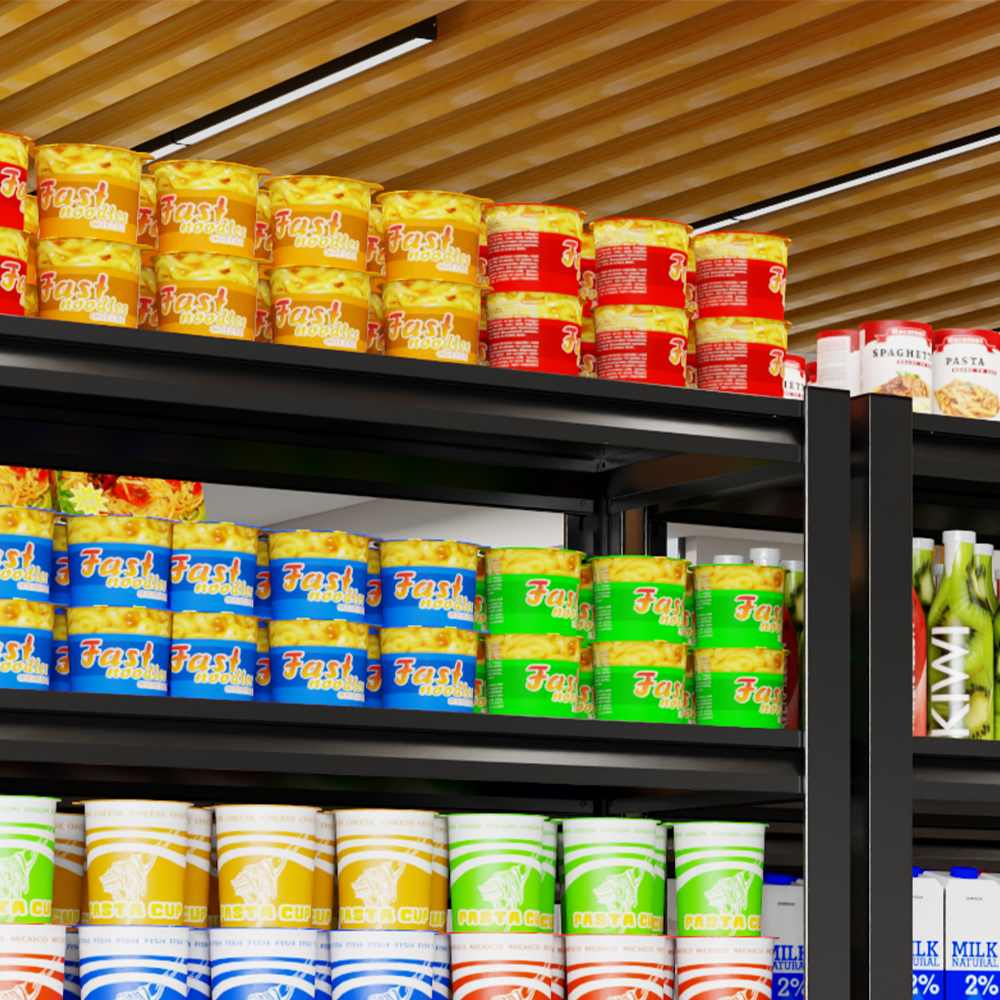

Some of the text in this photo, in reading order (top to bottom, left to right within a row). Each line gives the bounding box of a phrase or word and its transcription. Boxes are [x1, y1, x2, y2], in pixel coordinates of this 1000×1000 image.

[40, 179, 109, 210] Fast
[59, 204, 128, 222] noodles
[161, 194, 227, 225] Fast
[180, 218, 247, 237] noodles
[275, 209, 342, 239] Fast
[295, 233, 359, 253] noodles
[388, 224, 454, 253] Fast
[408, 247, 471, 266] noodles
[40, 271, 109, 302] Fast
[59, 296, 128, 314] noodles
[161, 285, 227, 316] Fast
[275, 298, 342, 328] Fast
[180, 309, 247, 328] noodles
[388, 311, 454, 341] Fast
[295, 322, 359, 342] noodles
[946, 357, 985, 366] PASTA
[80, 547, 154, 578] Fast
[170, 554, 241, 584] Fast
[282, 562, 353, 592] Fast
[394, 571, 463, 600] Fast
[80, 638, 154, 668] Fast
[170, 644, 241, 674] Fast
[282, 650, 353, 680] Fast
[394, 657, 463, 686] Fast
[931, 626, 970, 737] KIWI
[88, 900, 184, 919] PASTA CUP
[220, 904, 311, 922] PASTA CUP
[339, 906, 429, 924] PASTA CUP
[458, 909, 524, 927] PASTA
[684, 914, 747, 931] PASTA
[951, 941, 998, 958] MILK
[951, 957, 999, 968] NATURAL
[778, 977, 804, 997] 2%
[965, 974, 999, 995] 2%
